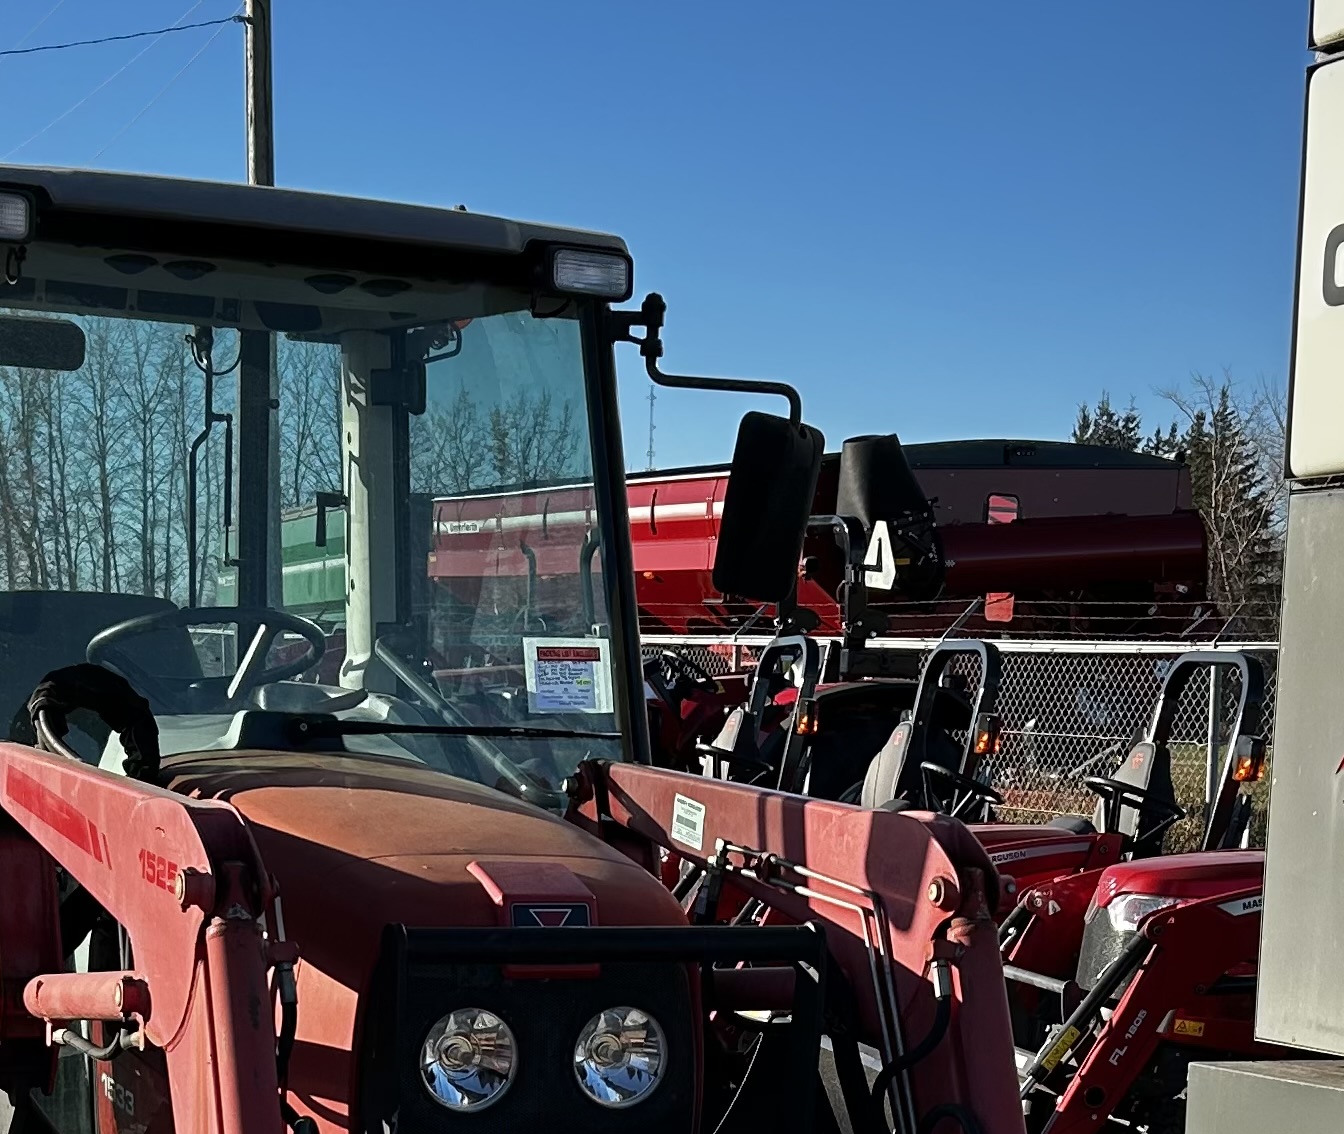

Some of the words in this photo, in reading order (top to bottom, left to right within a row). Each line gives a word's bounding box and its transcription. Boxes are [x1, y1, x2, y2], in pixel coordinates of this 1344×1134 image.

[139, 848, 178, 896] 1525
[1109, 1045, 1129, 1066] FL
[101, 1072, 134, 1117] 1533
